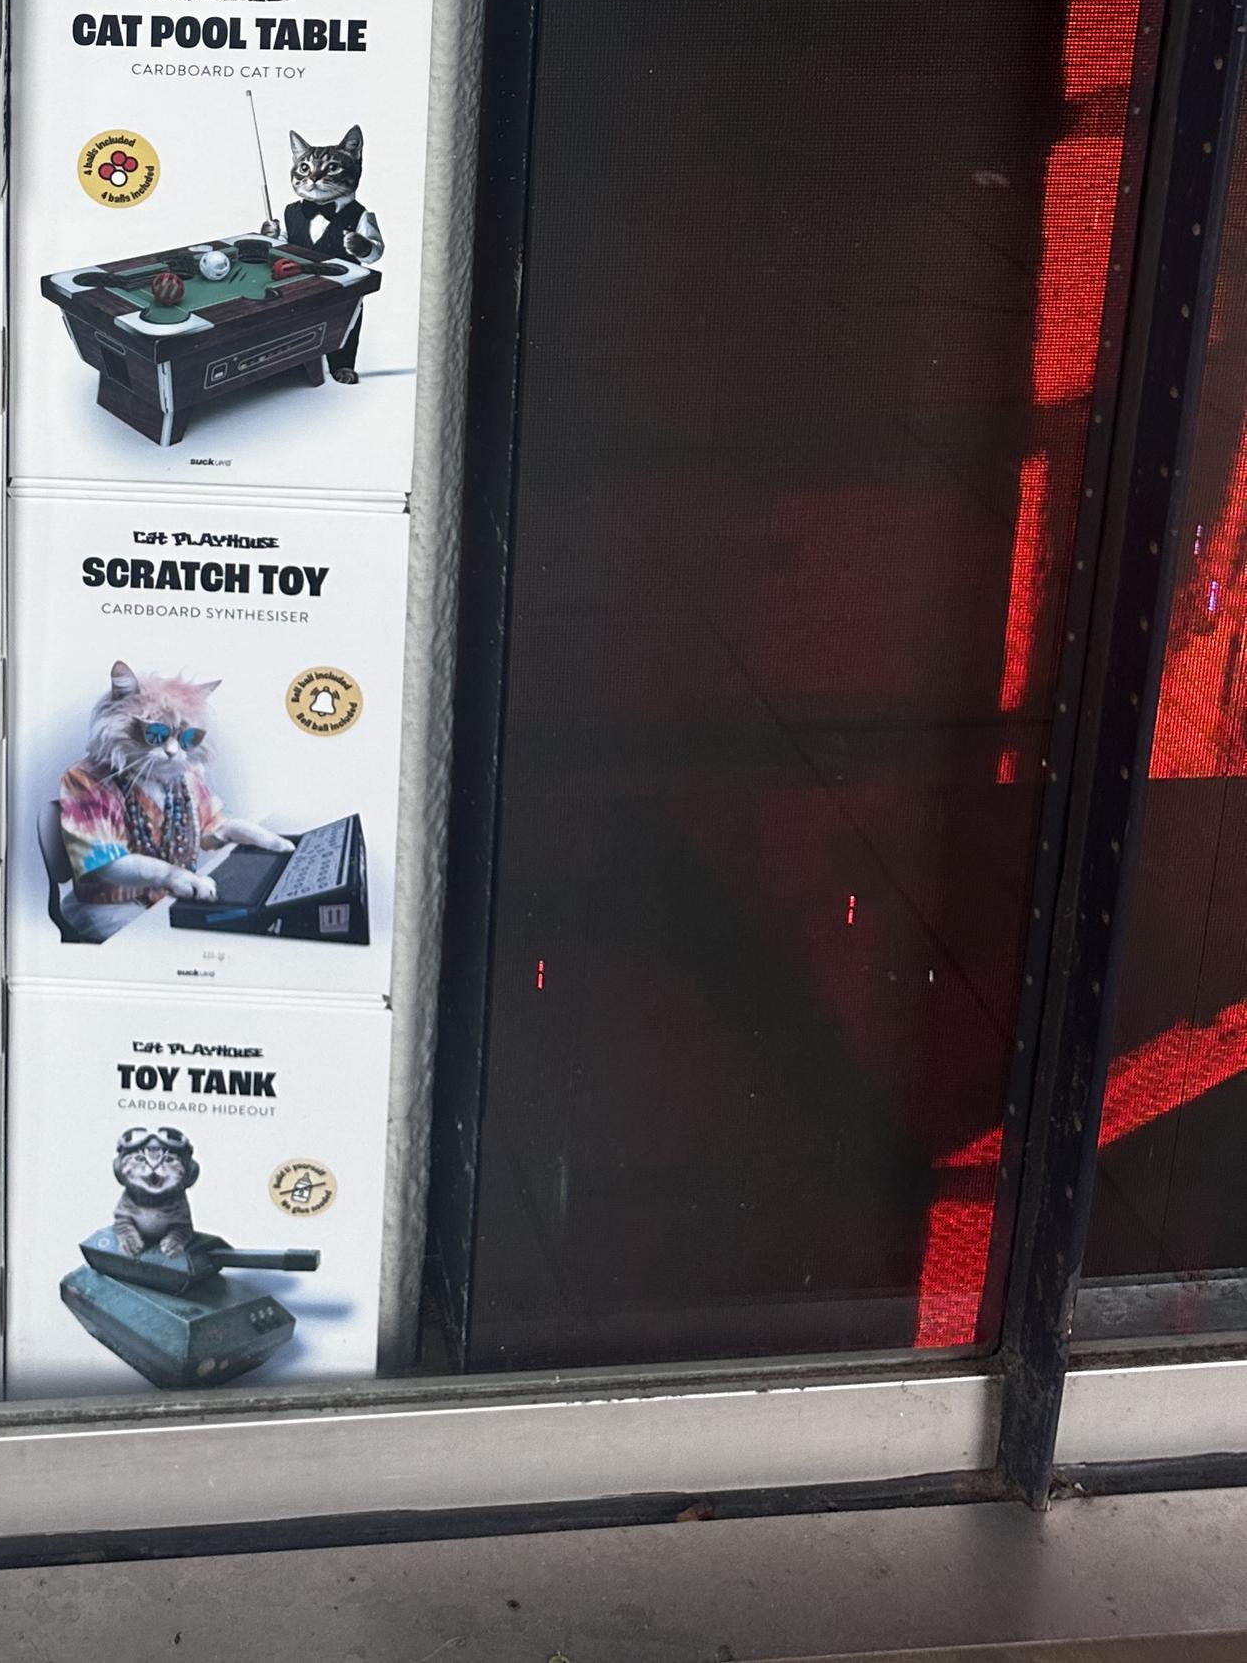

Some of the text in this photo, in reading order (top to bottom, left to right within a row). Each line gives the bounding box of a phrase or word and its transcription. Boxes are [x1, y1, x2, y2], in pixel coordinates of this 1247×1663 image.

[72, 13, 367, 52] CAT POOL TABLE
[131, 63, 306, 79] CARDBOARD CAT TOY
[82, 556, 330, 597] SCRATCH TOY
[101, 603, 309, 623] CARDBOARD SYNTHESISER
[117, 1063, 277, 1098] TOY TANK
[117, 1098, 276, 1117] CARDBOARD HIDEOUT
